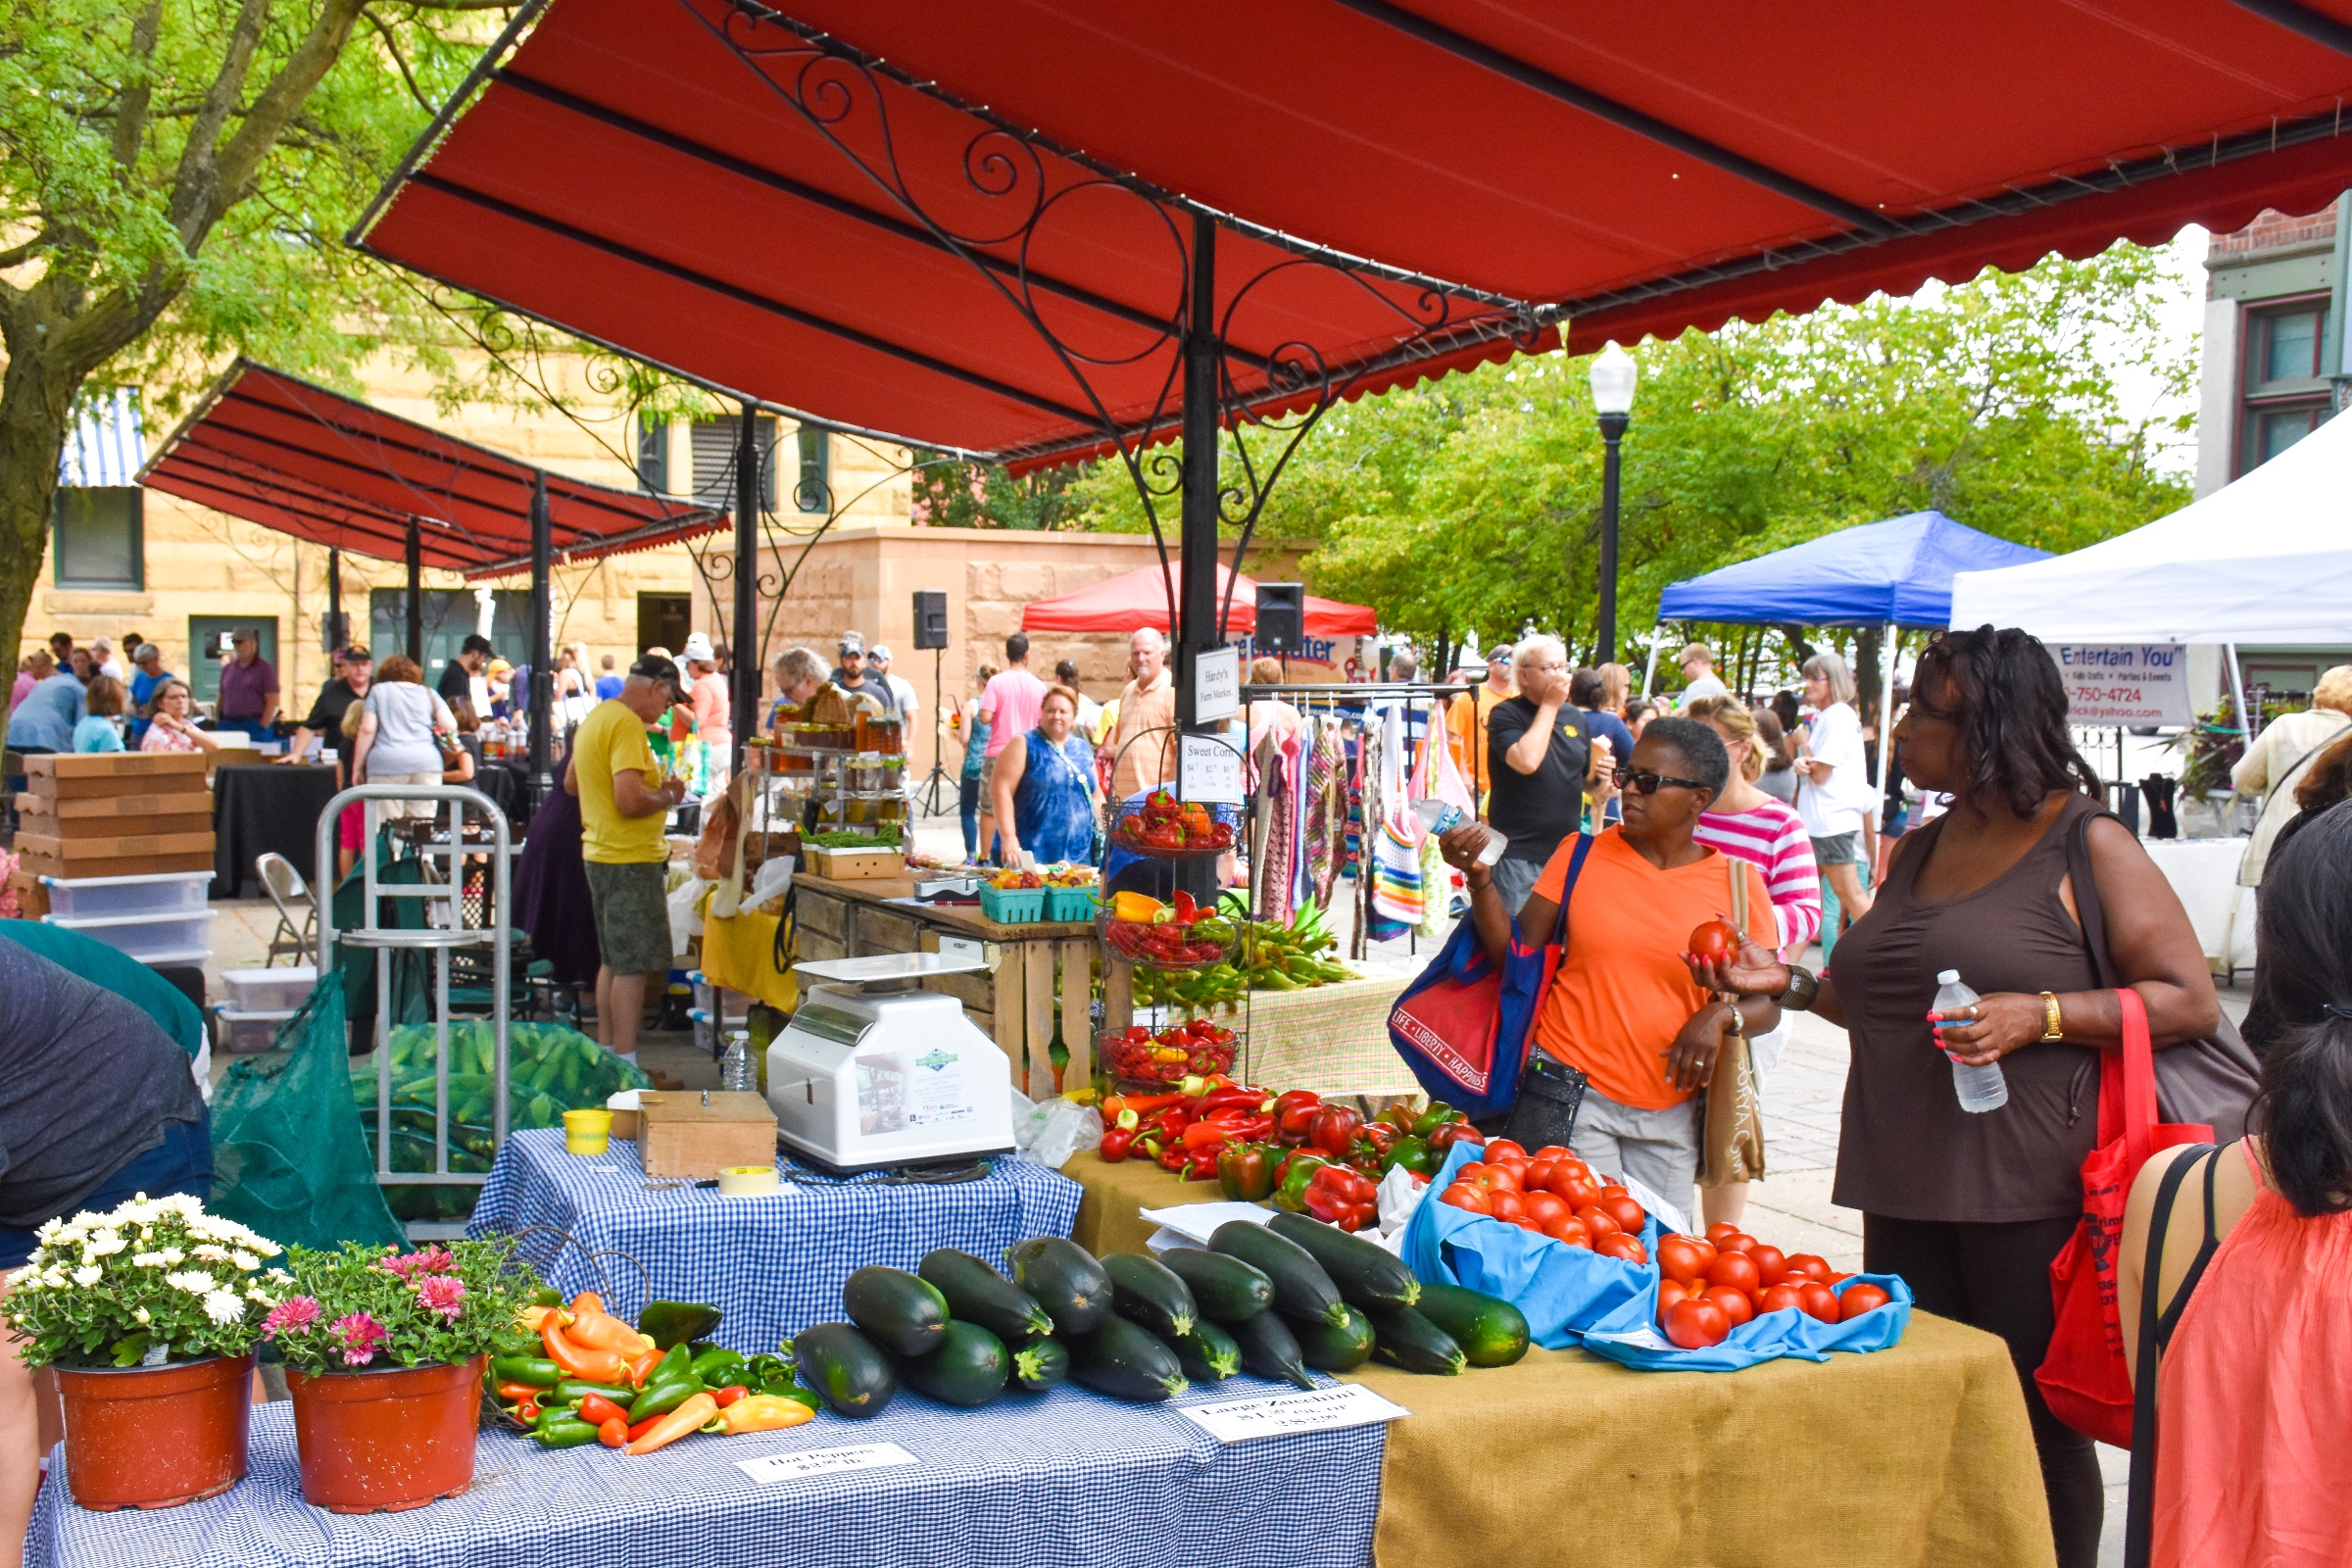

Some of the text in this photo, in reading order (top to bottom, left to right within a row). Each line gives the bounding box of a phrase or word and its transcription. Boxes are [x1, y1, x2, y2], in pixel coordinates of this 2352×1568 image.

[2060, 647, 2133, 666] Entertain
[1204, 668, 1228, 683] Hardy's
[2118, 672, 2140, 681] Parties
[2148, 672, 2172, 681] Events
[1200, 692, 1213, 702] Farm
[1188, 745, 1234, 758] Sweet Corn
[1392, 1010, 1411, 1030] LIFE
[1414, 1028, 1446, 1056] LIBERTY
[1200, 1391, 1356, 1415] Large Zucchini
[769, 1449, 874, 1466] Hot Peppers
